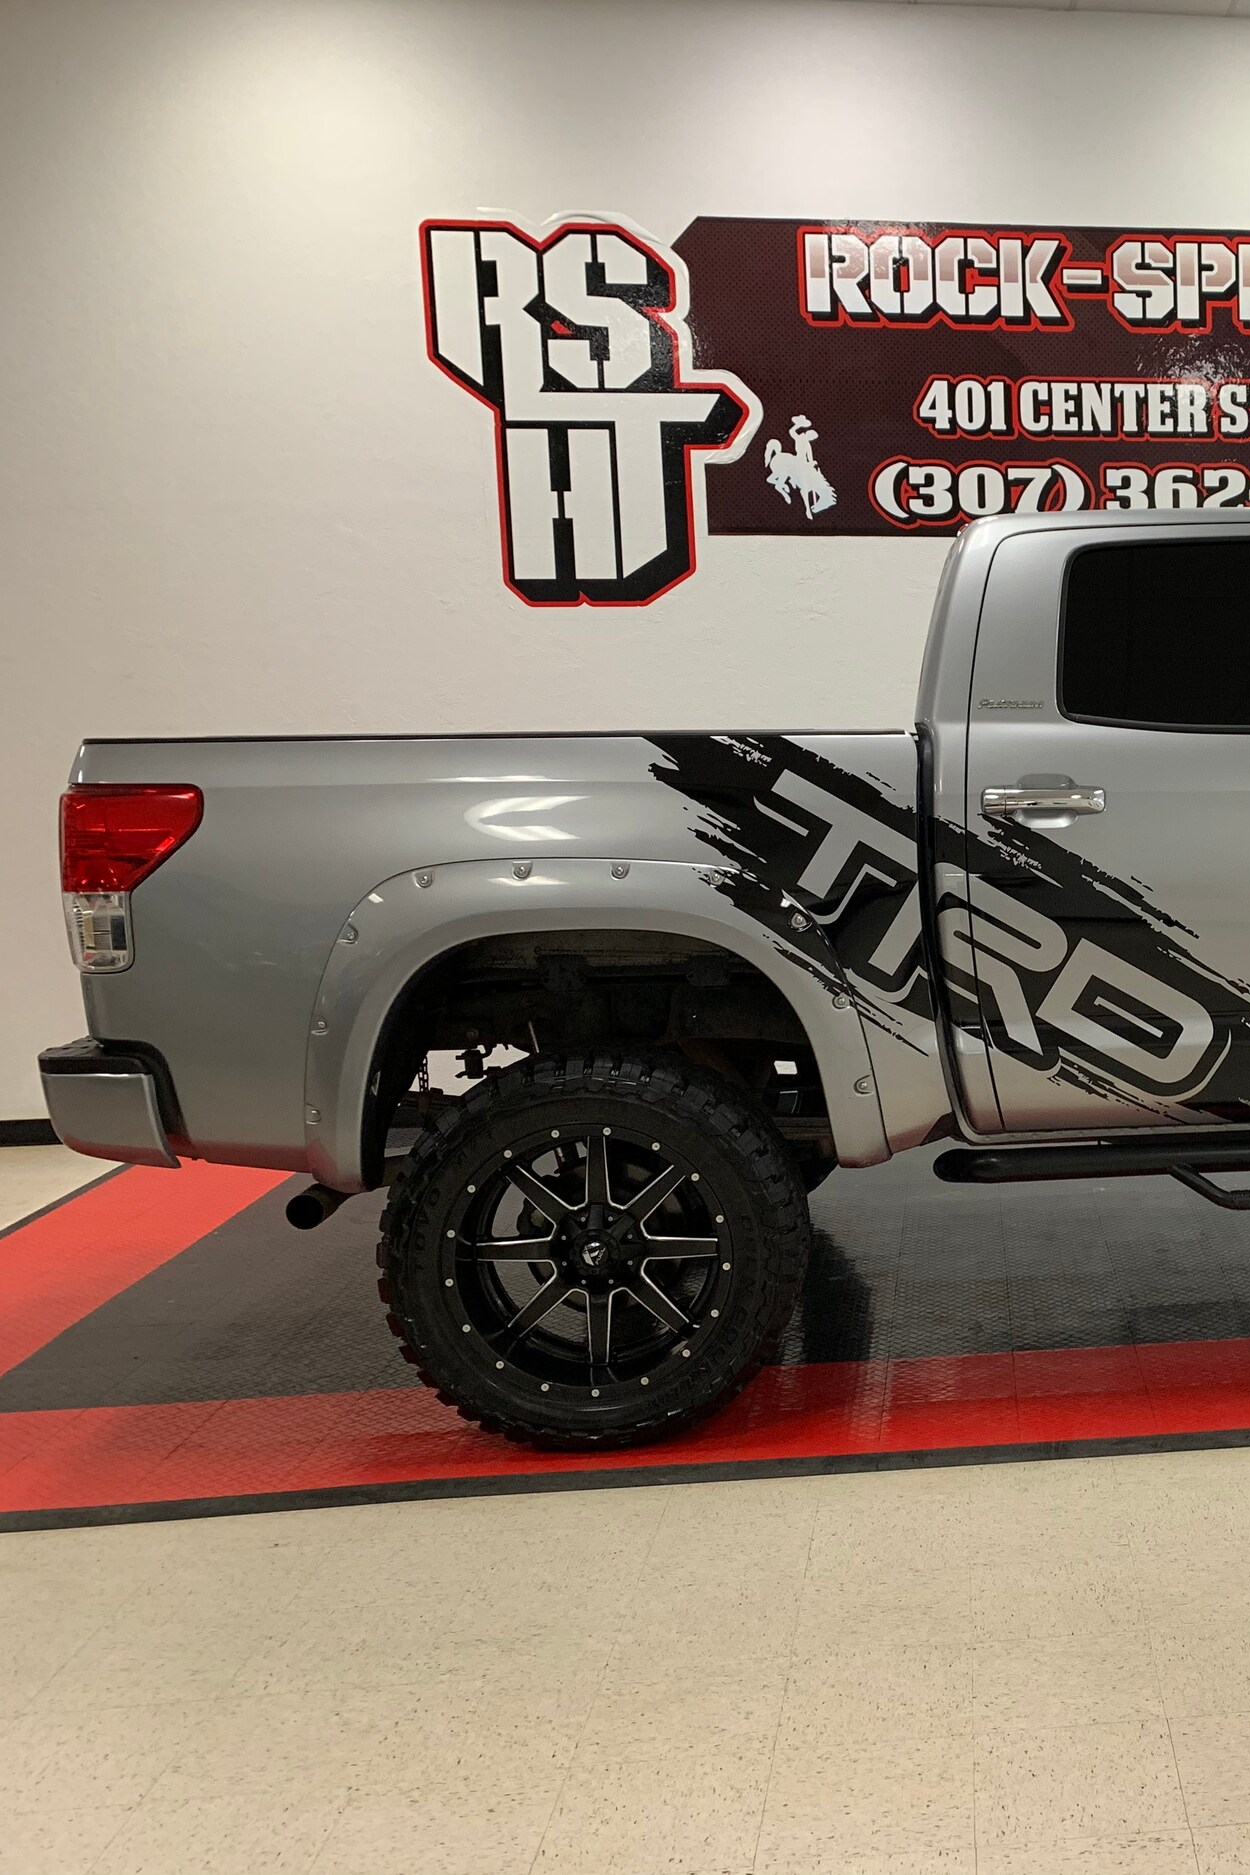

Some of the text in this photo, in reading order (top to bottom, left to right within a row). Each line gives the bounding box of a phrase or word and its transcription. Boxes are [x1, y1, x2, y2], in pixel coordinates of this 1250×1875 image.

[919, 380, 1009, 430] 401
[1018, 381, 1209, 435] CENTER
[873, 461, 1086, 519] (307)
[753, 767, 1231, 1102] TRD
